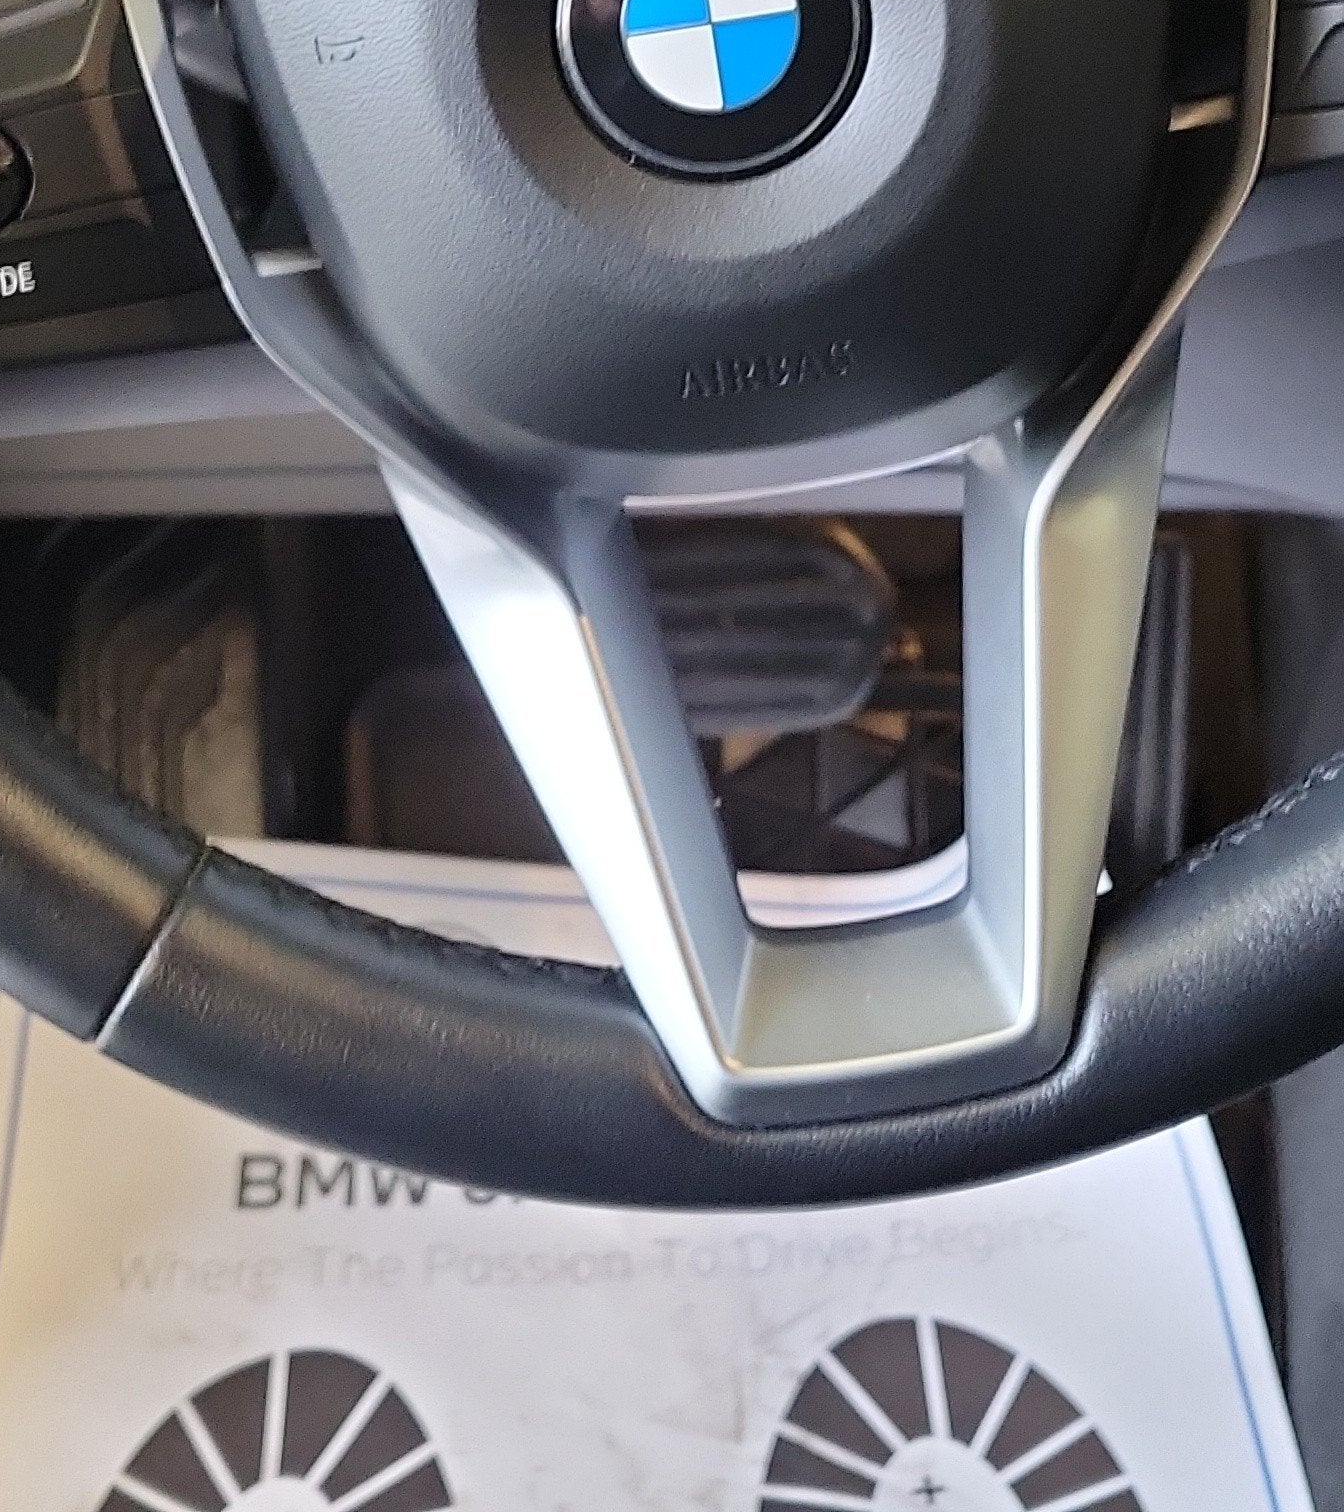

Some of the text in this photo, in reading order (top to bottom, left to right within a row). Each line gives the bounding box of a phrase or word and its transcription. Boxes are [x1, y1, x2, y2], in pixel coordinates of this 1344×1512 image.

[237, 1152, 429, 1209] BMW
[112, 1248, 282, 1293] Where
[304, 1244, 406, 1288] The
[423, 1241, 634, 1287] Passion
[654, 1238, 720, 1279] To
